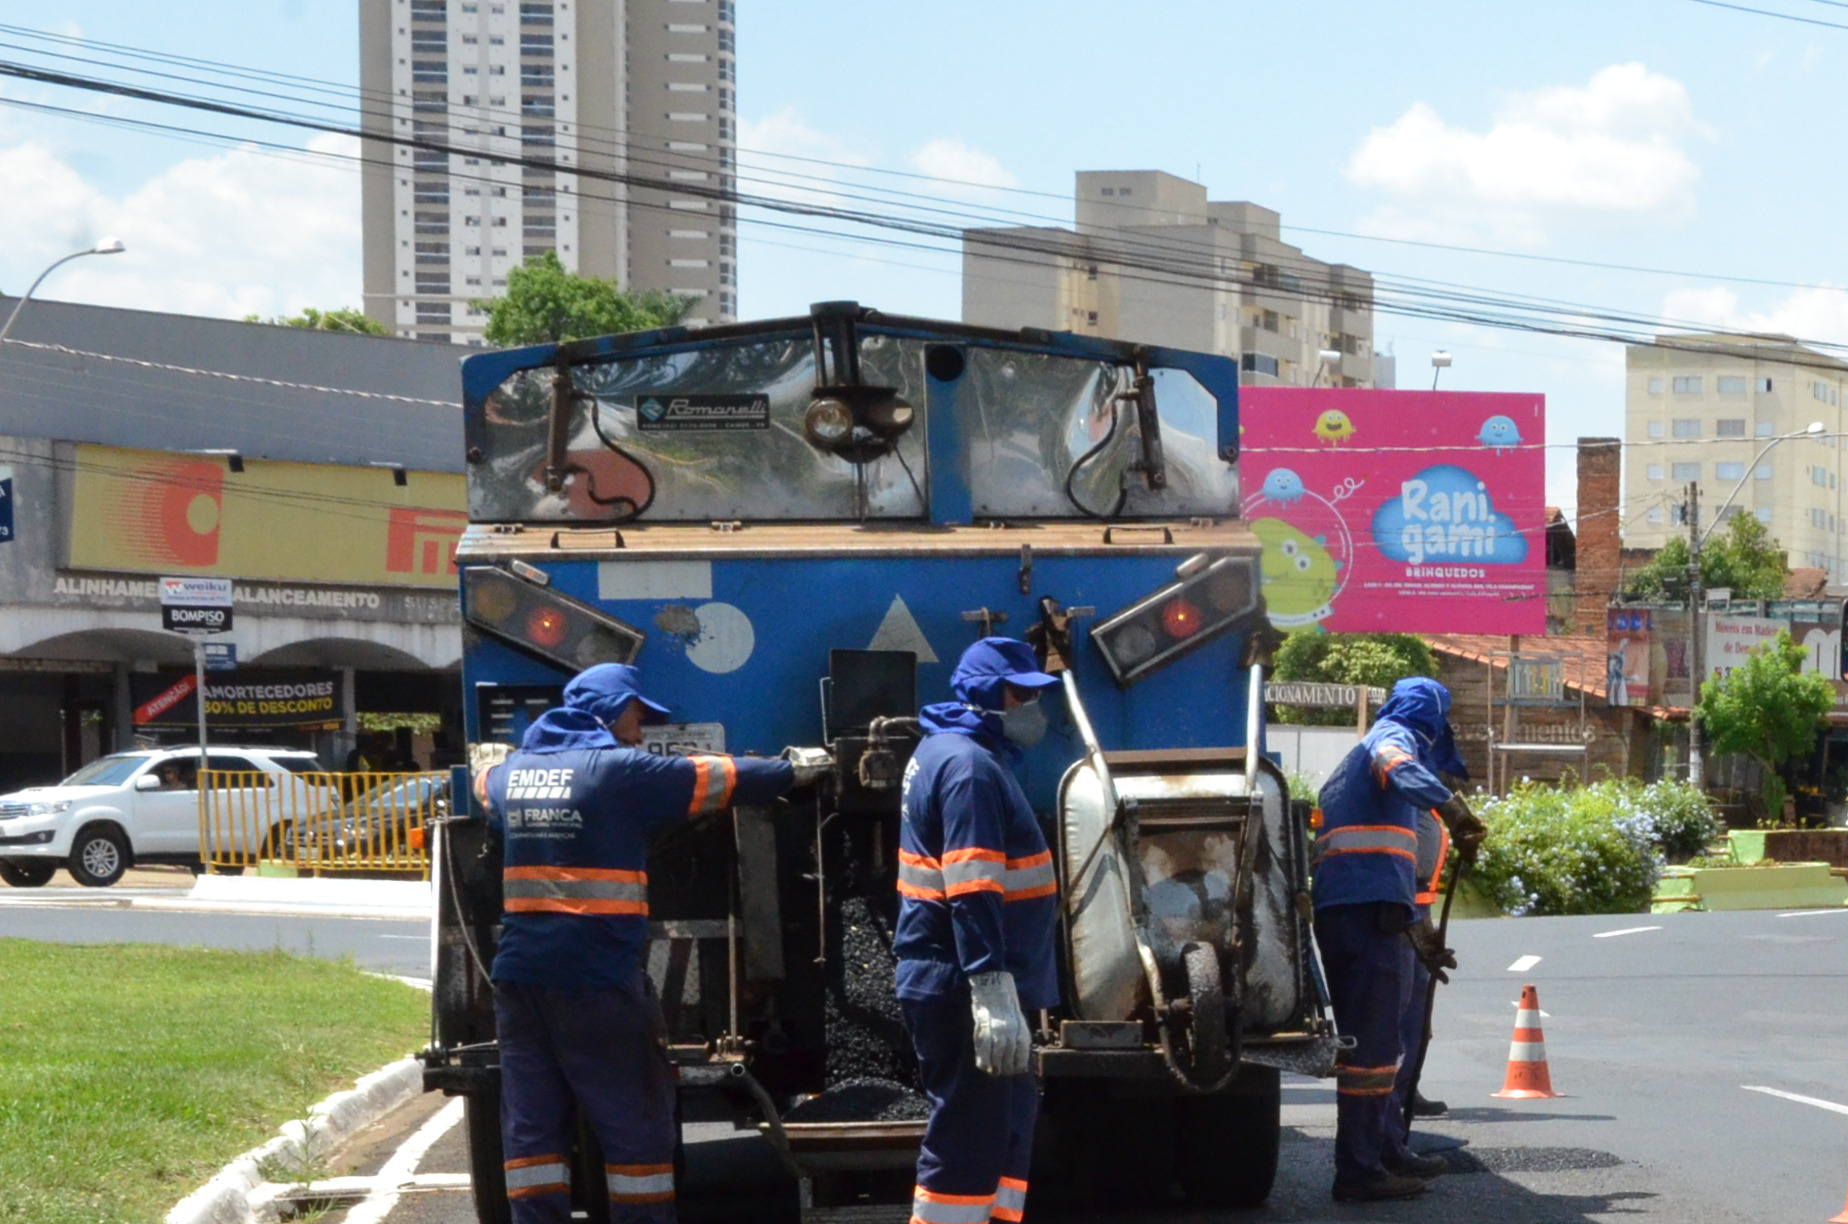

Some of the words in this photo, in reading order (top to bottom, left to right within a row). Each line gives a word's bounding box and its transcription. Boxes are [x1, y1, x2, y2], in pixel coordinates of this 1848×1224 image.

[667, 399, 767, 415] Romanelli
[1401, 523, 1496, 566] gami
[1406, 567, 1486, 578] BRINQUEDOS
[54, 577, 157, 598] ALINHAME
[231, 586, 381, 609] ALANCEAMENTO
[184, 581, 227, 591] weiku
[171, 609, 225, 622] BOMPISO
[146, 680, 191, 716] ATENÇÃO!
[202, 681, 334, 700] AMORTECEDORES
[204, 700, 235, 714] 30%
[237, 700, 256, 714] DE
[259, 697, 333, 714] DESCONTO
[508, 768, 575, 787] EMDEF
[524, 808, 583, 822] FRANCA
